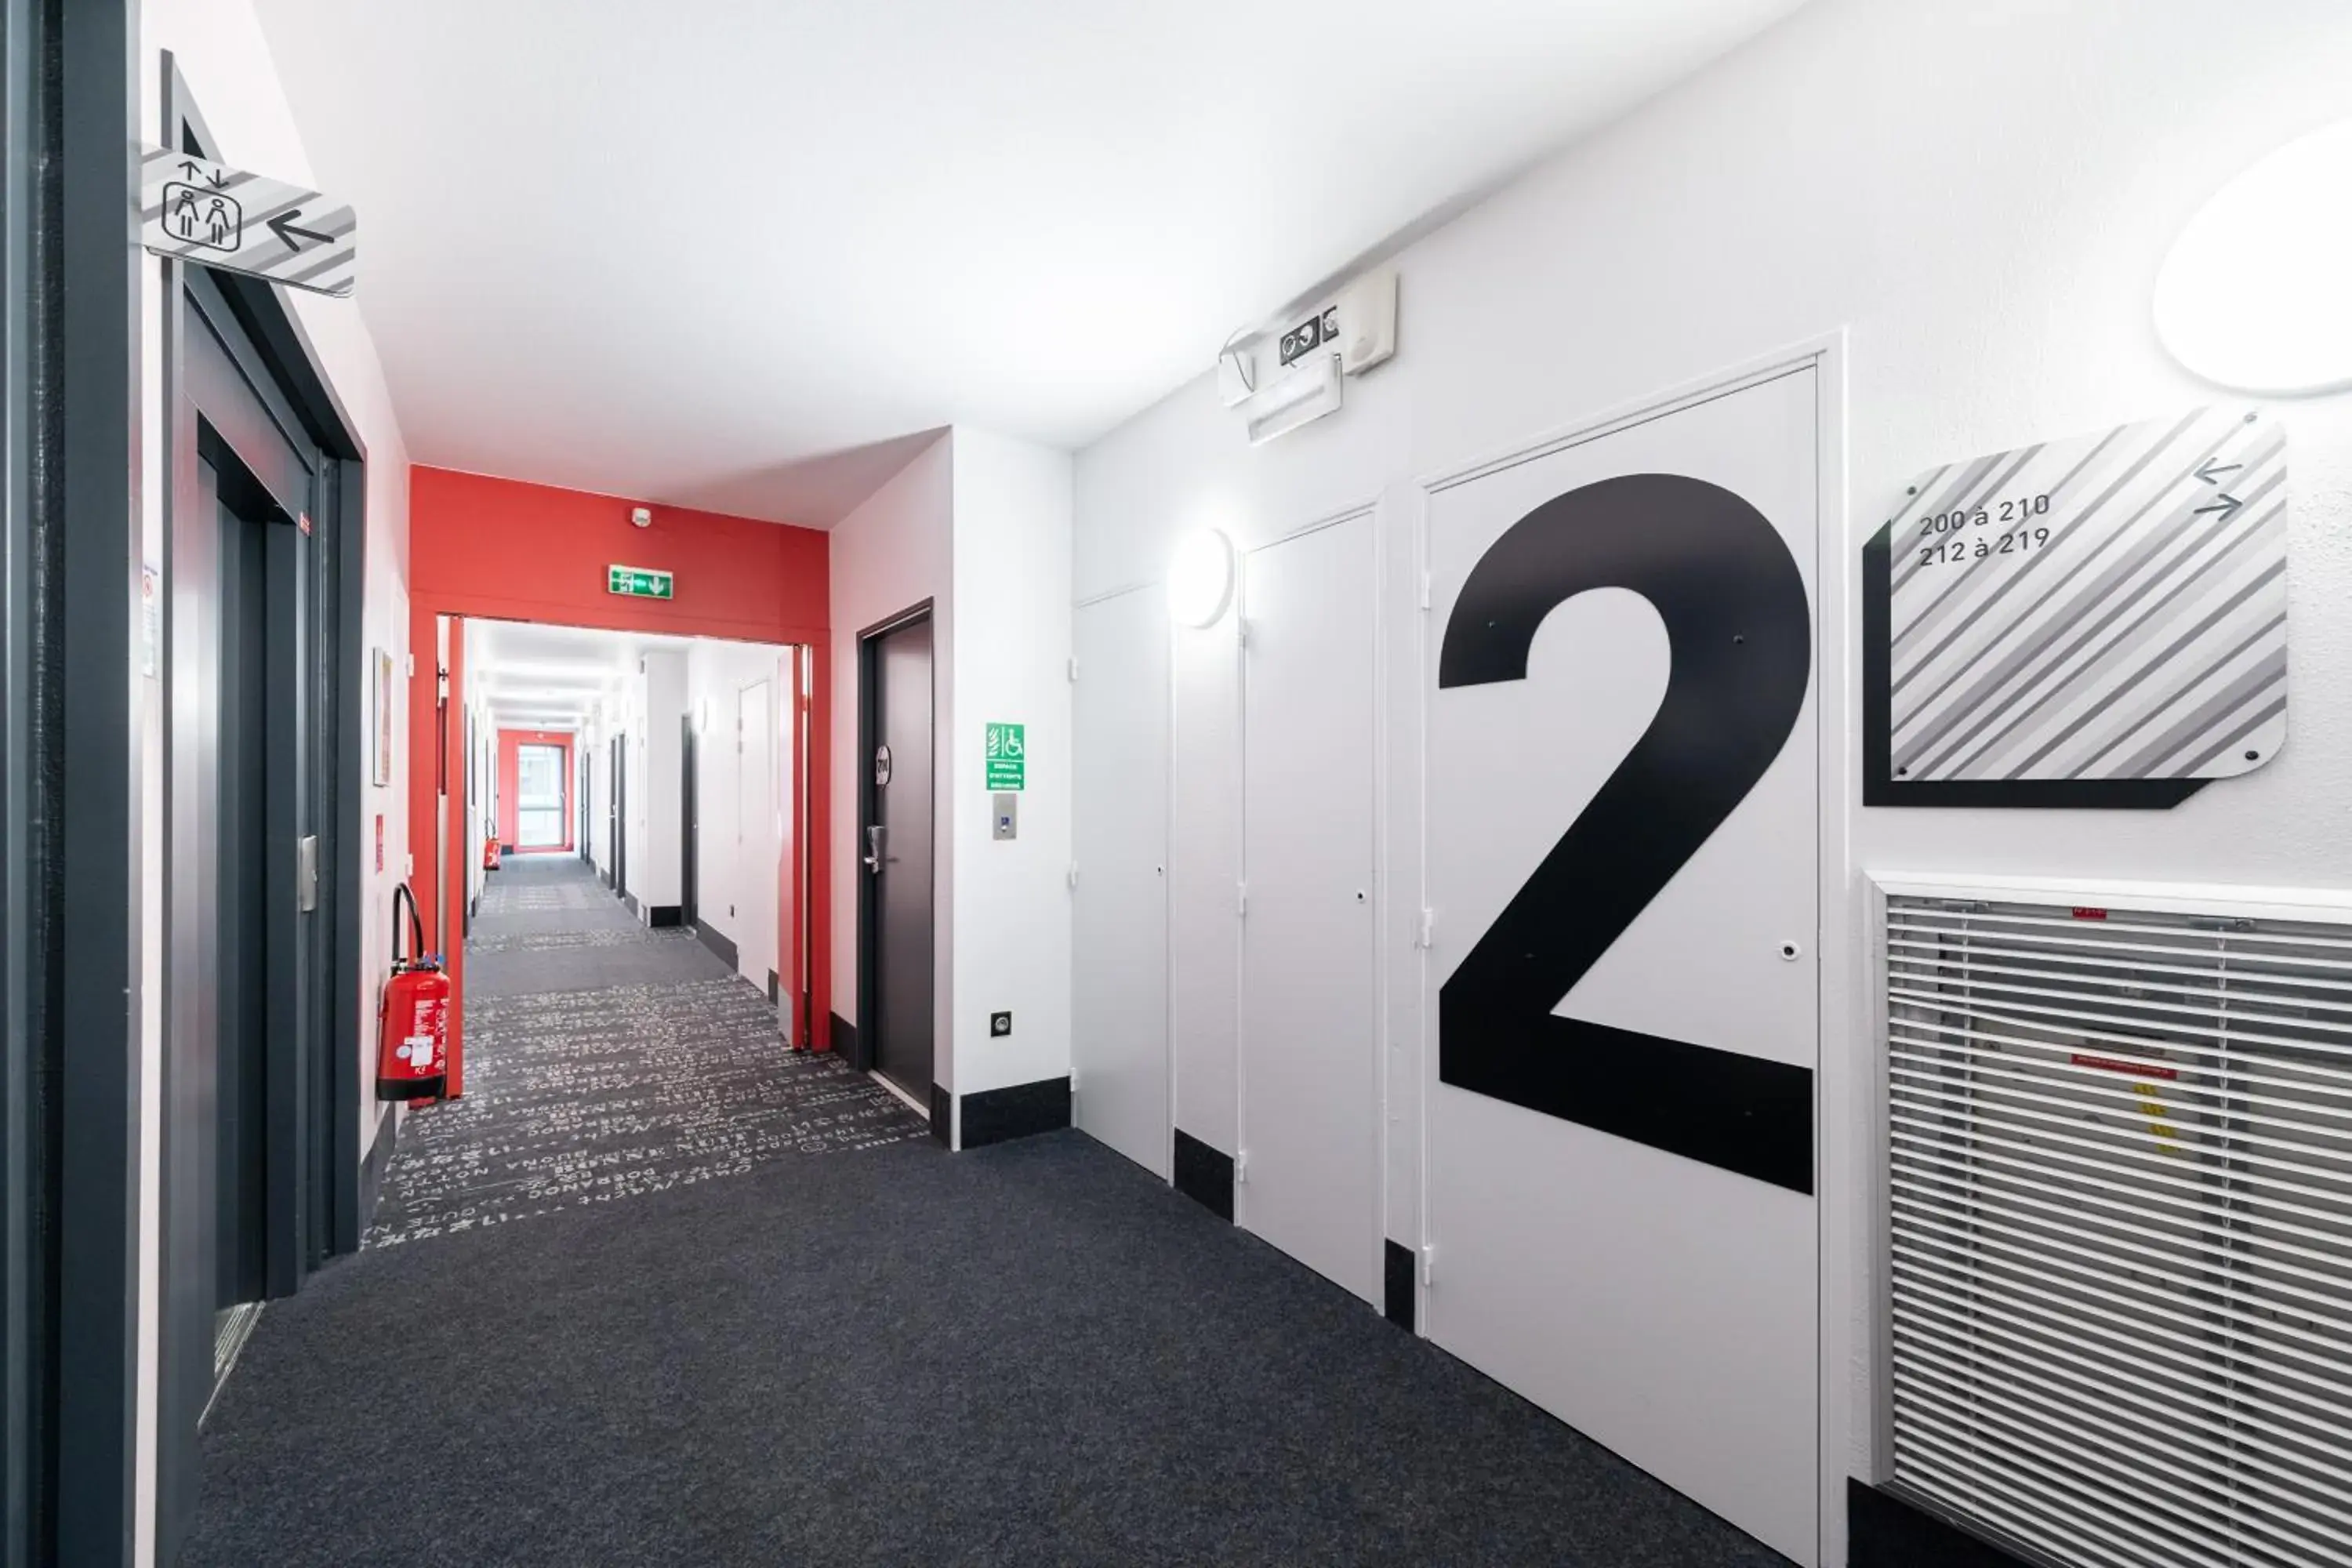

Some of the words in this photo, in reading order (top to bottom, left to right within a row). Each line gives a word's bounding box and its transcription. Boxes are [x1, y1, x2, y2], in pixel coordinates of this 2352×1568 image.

[1920, 511, 1965, 536] 200
[1974, 506, 1988, 526] à
[1999, 495, 2049, 521] 210
[1920, 542, 1965, 566] 212
[1974, 538, 1989, 557] à
[1999, 528, 2049, 554] 219
[1439, 474, 1813, 1196] 2
